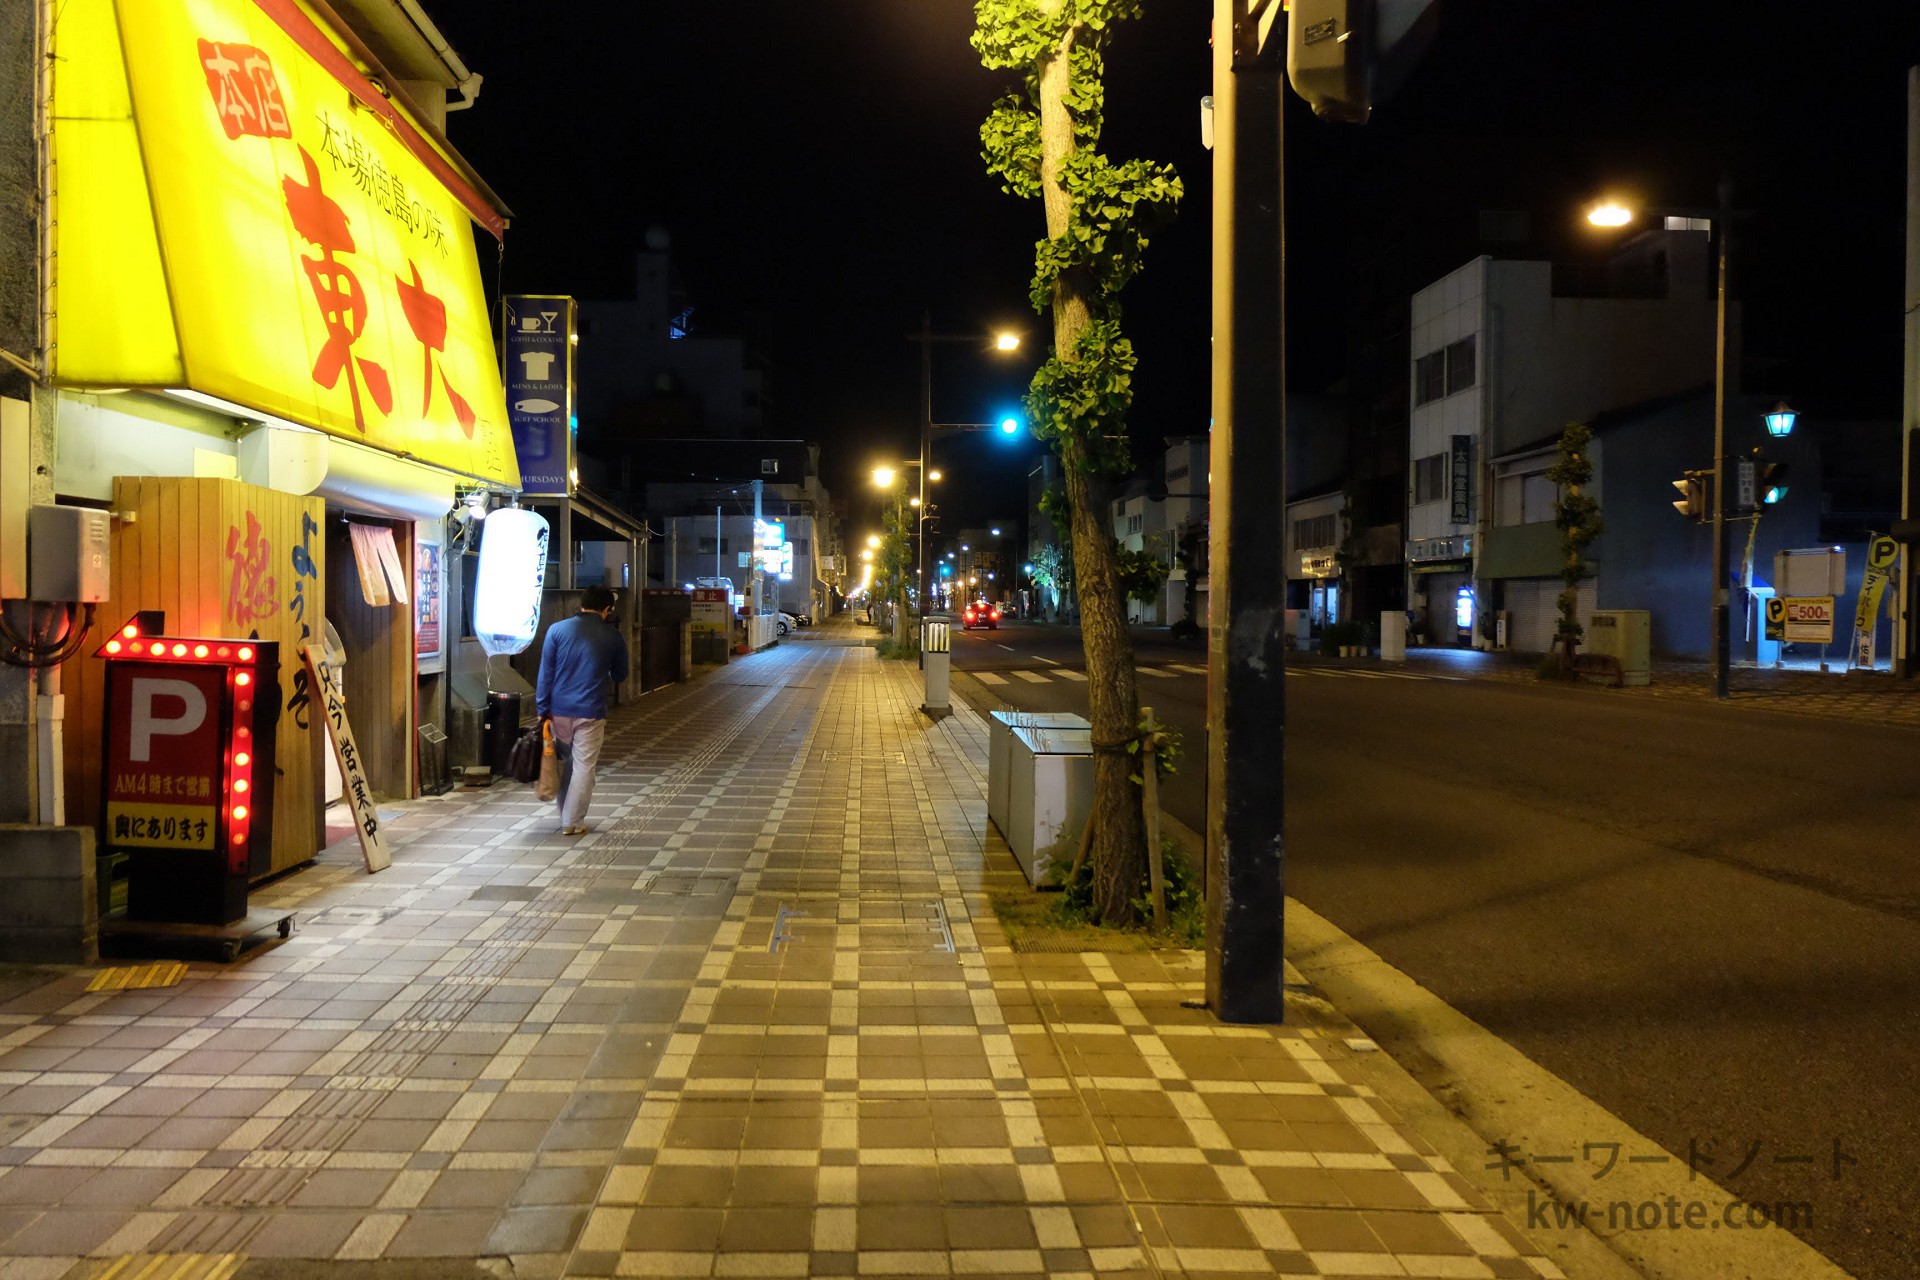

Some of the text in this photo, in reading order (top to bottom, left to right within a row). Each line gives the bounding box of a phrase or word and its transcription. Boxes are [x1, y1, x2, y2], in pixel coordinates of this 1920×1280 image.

[204, 43, 290, 134] 本店
[315, 110, 449, 259] 本場徳島の味
[281, 142, 476, 440] 東大
[1874, 541, 1896, 564] P
[1769, 600, 1783, 620] P
[129, 677, 208, 762] P
[317, 660, 379, 847] 只今営業中
[115, 814, 209, 843] 奥にあります
